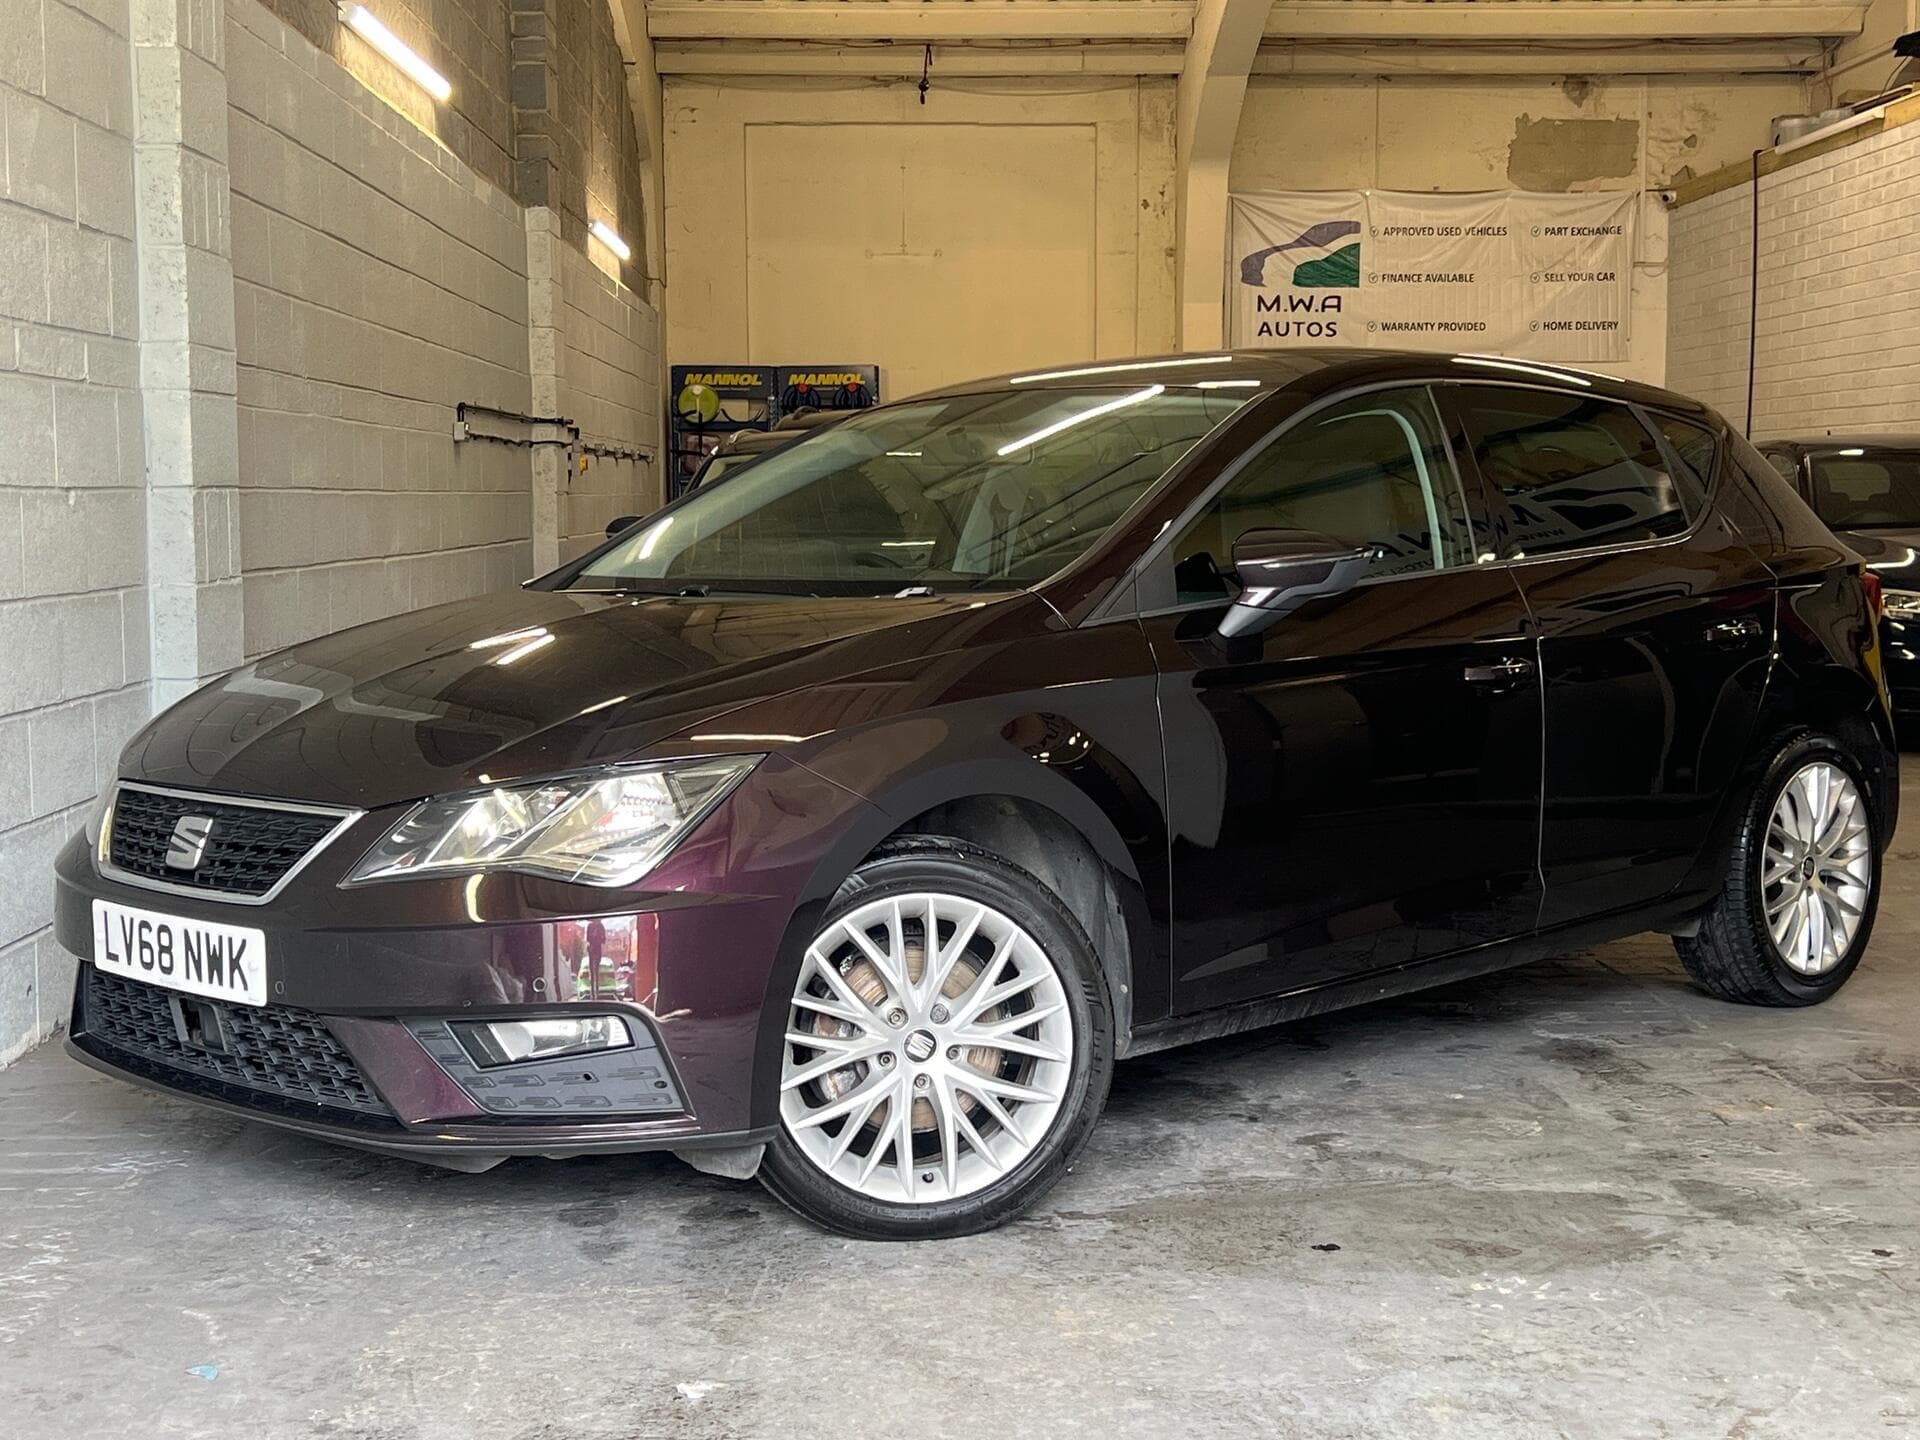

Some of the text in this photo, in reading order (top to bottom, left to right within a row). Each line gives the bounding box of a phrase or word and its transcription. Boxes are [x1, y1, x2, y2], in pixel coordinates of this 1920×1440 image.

[1383, 226, 1508, 236] APPROVED USED VEHICLES
[1544, 225, 1623, 236] PART EXCHANGE
[1381, 273, 1475, 283] FINANCE AVAILABLE
[1544, 272, 1616, 282] SELL YOUR CAR
[1257, 294, 1342, 312] M.W.A
[1257, 321, 1338, 337] AUTOS
[1381, 322, 1486, 331] WARRANTY PROVIDED
[1543, 321, 1619, 331] HOME DELIVERY
[684, 373, 762, 386] MANNOL
[788, 373, 866, 386] MANNOL
[103, 911, 249, 992] LV68 NWK
